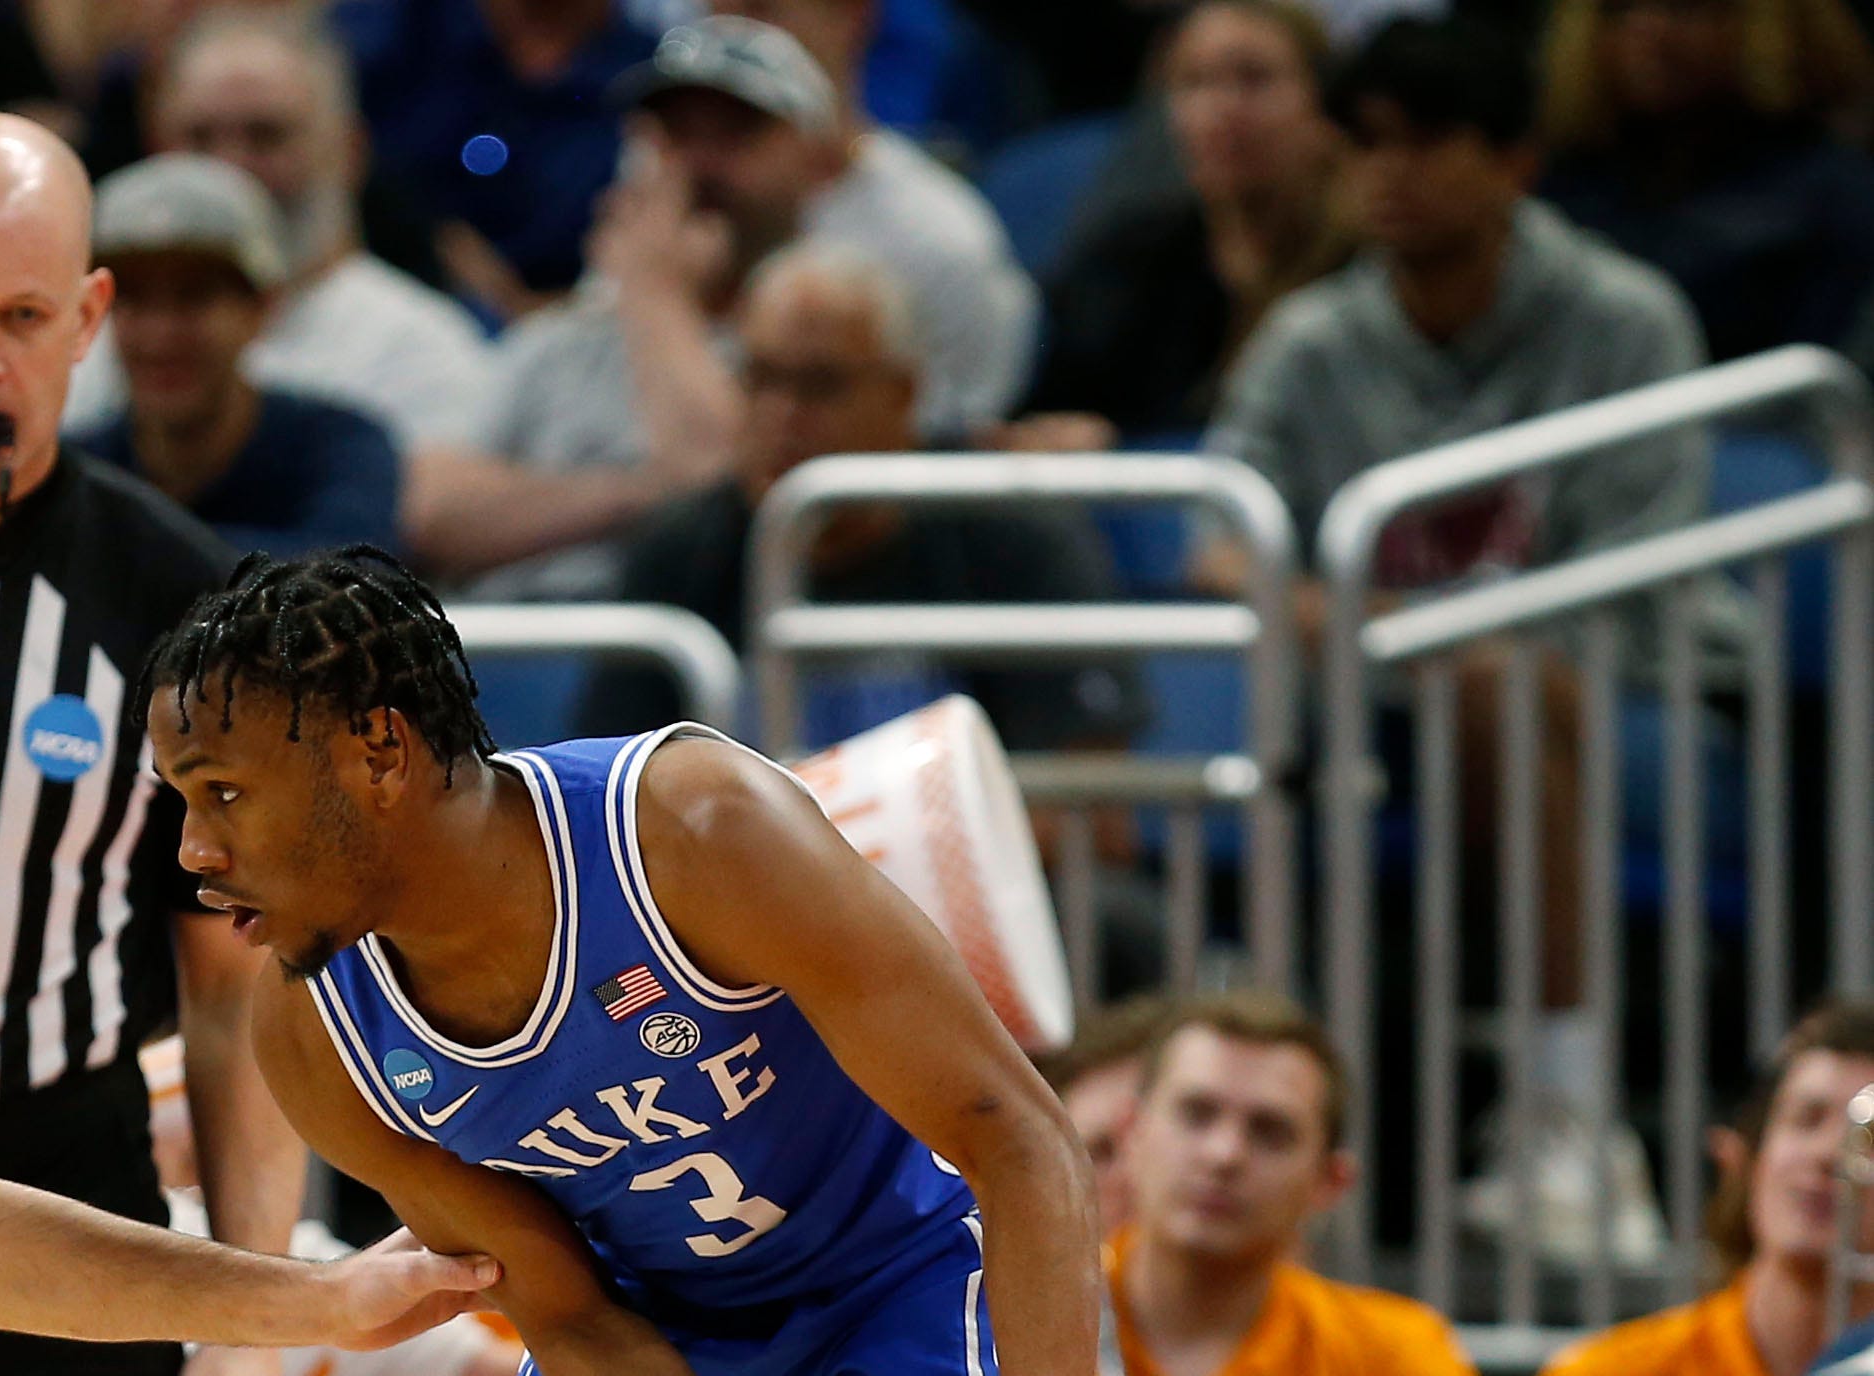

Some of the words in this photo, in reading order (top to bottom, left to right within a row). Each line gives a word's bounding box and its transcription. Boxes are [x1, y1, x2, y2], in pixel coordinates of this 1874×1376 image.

[392, 1067, 433, 1091] NCAA
[480, 1031, 777, 1178] UKE
[629, 1151, 789, 1258] 3
